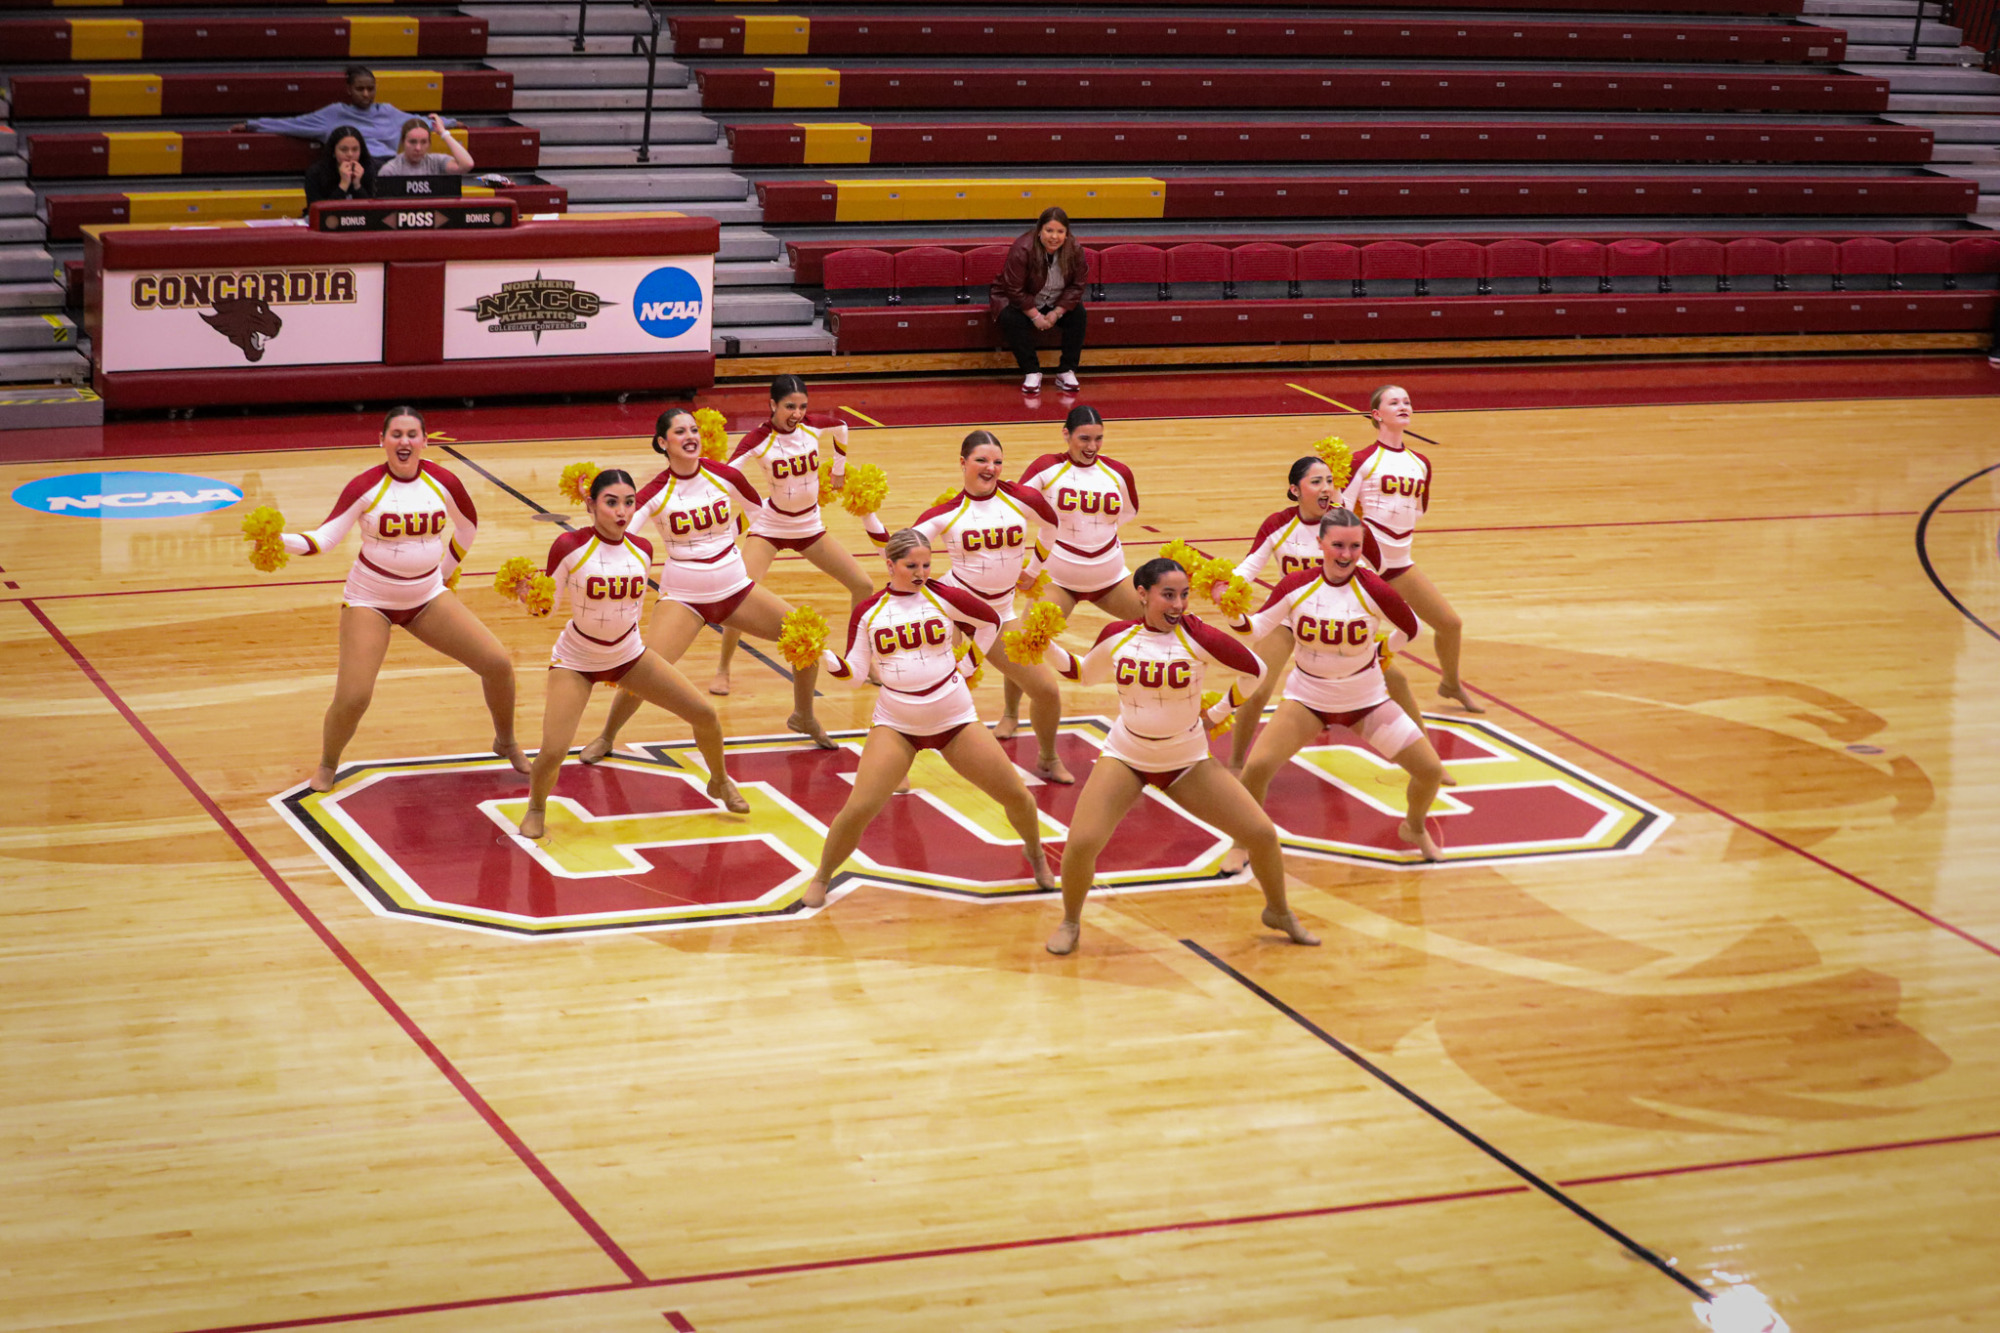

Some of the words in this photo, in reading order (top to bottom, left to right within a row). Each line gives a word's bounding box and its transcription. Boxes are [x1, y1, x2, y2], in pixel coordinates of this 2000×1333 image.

[340, 216, 366, 226] BONUS
[398, 212, 434, 227] POSS
[465, 213, 490, 223] BONUS
[132, 268, 357, 310] CONCORDIA
[502, 280, 575, 292] NORTHERN
[478, 290, 600, 318] NACC
[500, 311, 576, 323] ATHLETICS
[639, 301, 700, 321] NCAA
[772, 450, 819, 479] CUC
[46, 489, 242, 511] NCAA
[1057, 486, 1121, 516] CUC
[379, 510, 447, 537] CUC
[669, 500, 730, 535] CUC
[961, 525, 1023, 552] CUC
[585, 575, 645, 600] CUC
[874, 618, 946, 655] CUC
[1297, 615, 1369, 646] CUC
[1115, 656, 1191, 689] CUC
